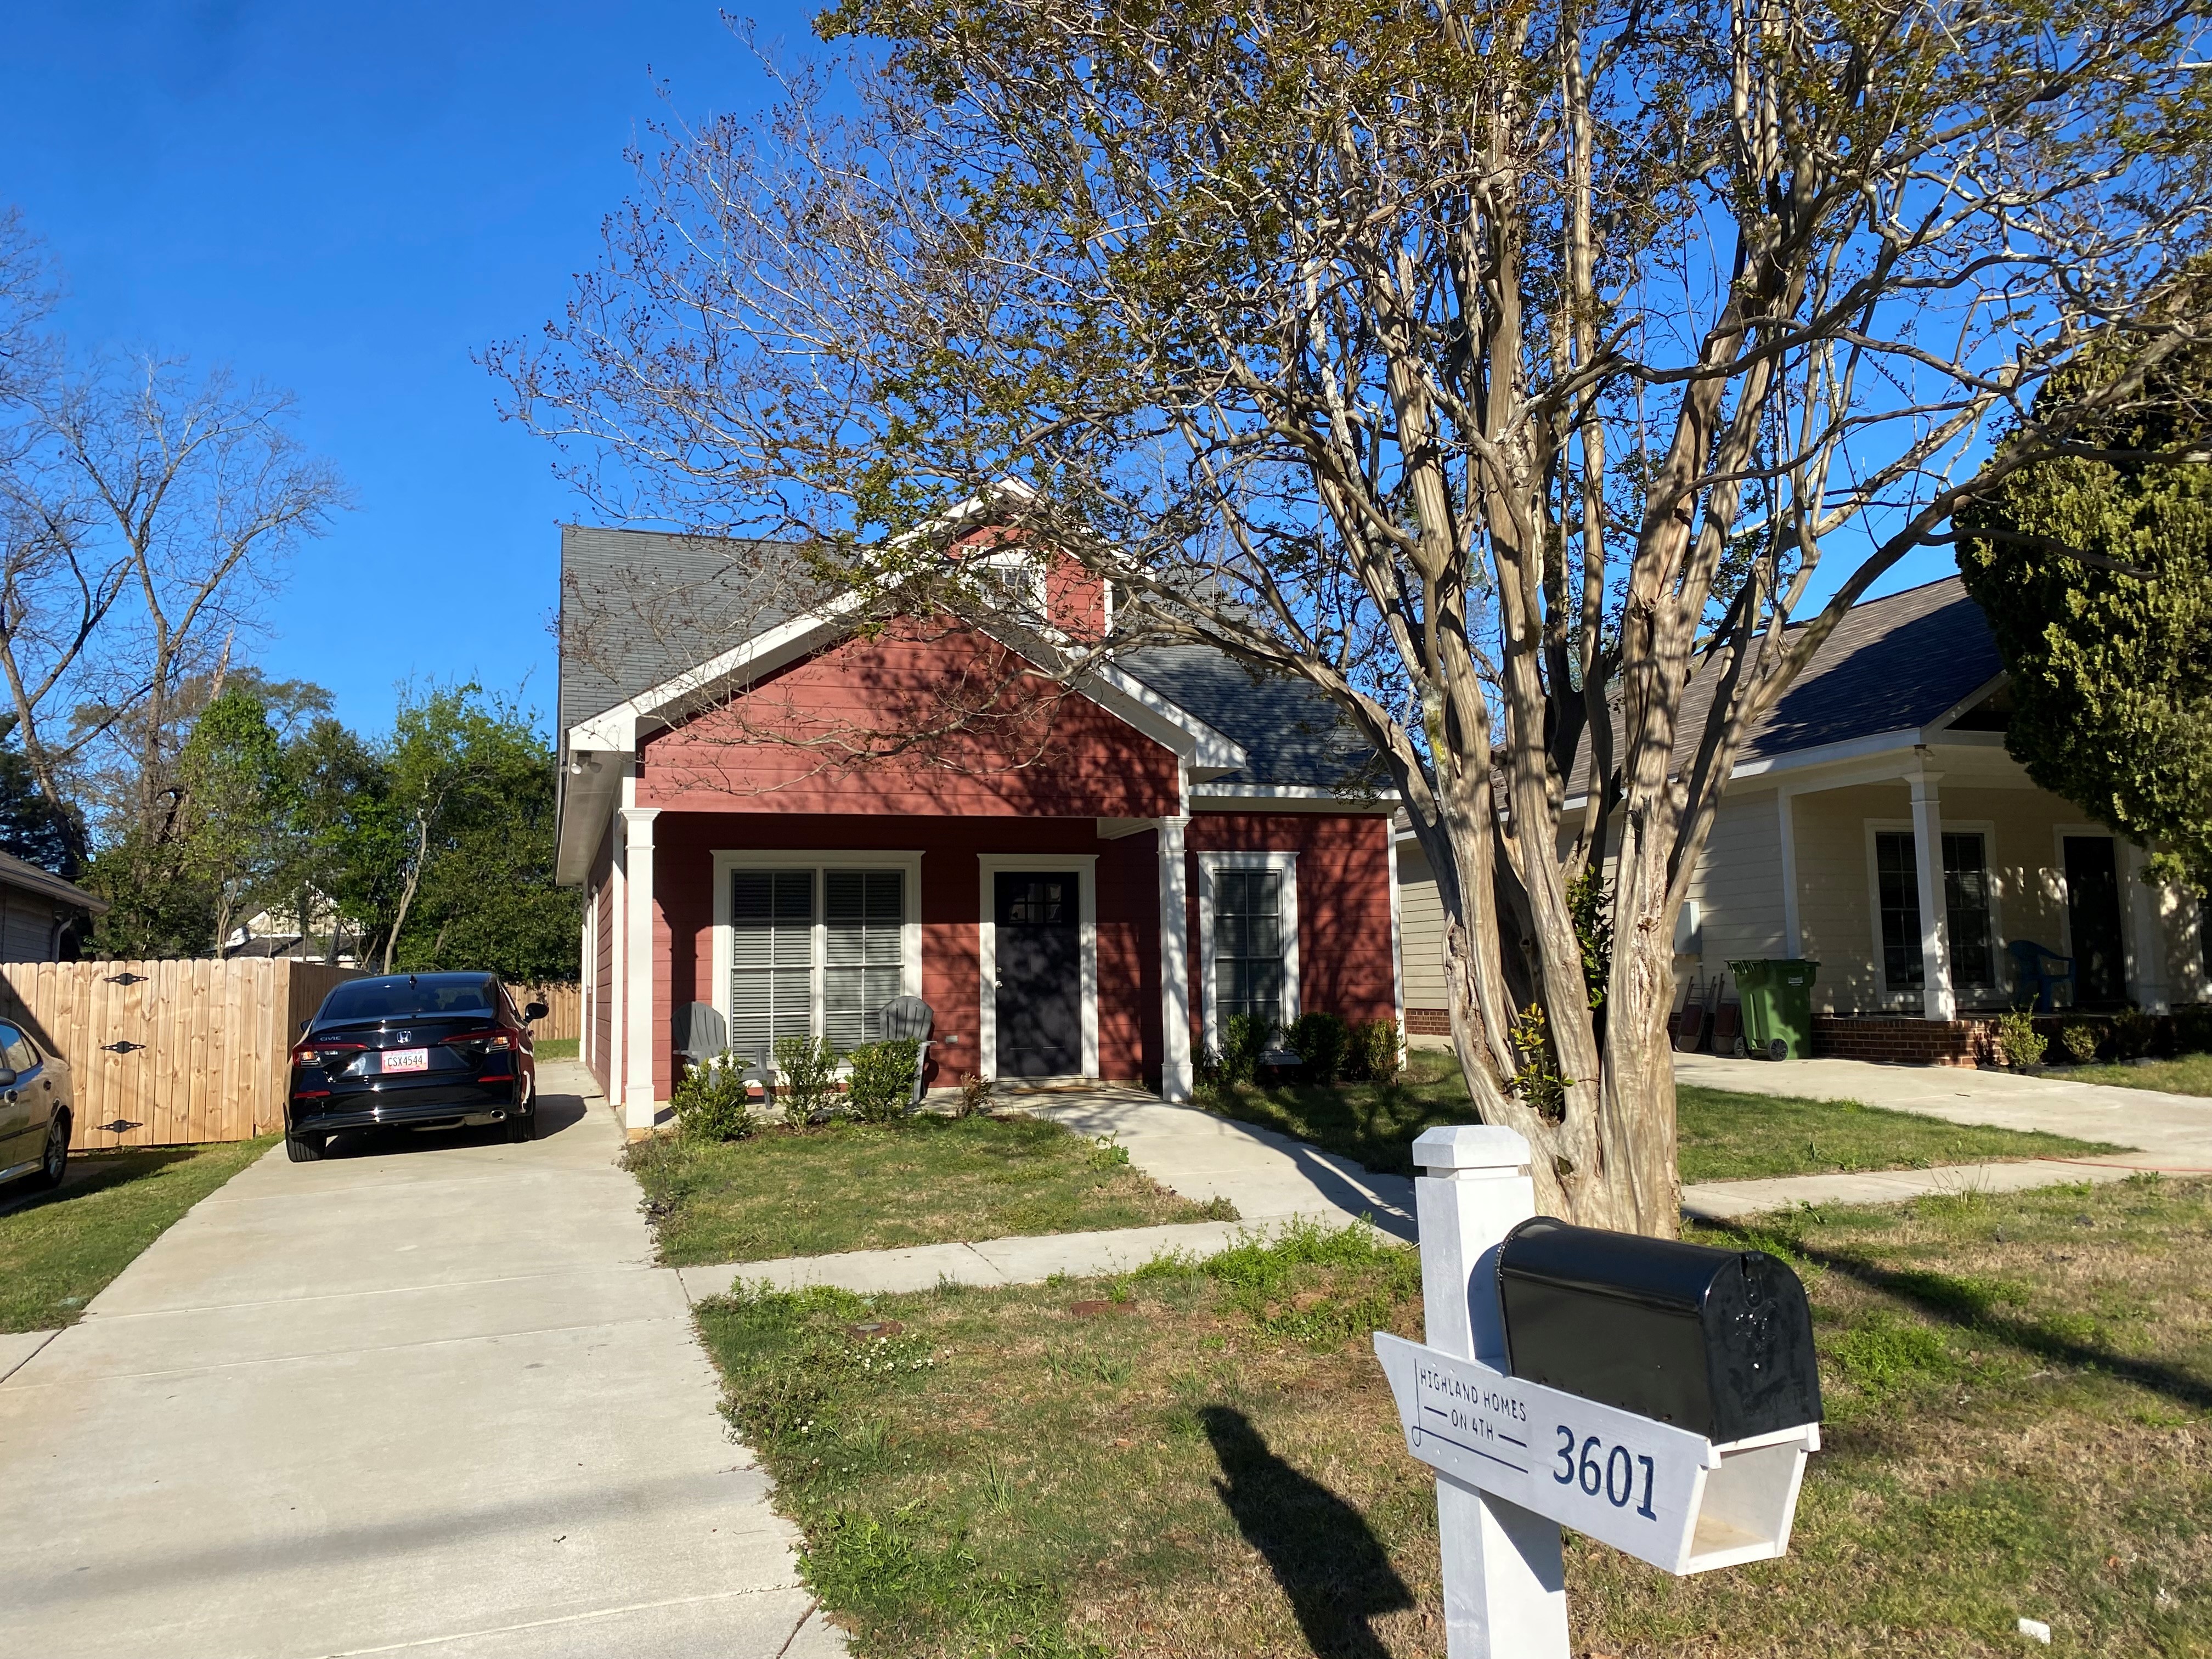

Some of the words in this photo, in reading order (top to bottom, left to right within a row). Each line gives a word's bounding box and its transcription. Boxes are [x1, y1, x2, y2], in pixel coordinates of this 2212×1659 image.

[387, 1054, 422, 1067] CSX4544
[1420, 1368, 1479, 1404] HIGHLAND
[1483, 1390, 1527, 1422] HOMES
[1451, 1409, 1467, 1431] ON
[1472, 1418, 1494, 1441] 4TH
[1553, 1425, 1657, 1522] 3601
